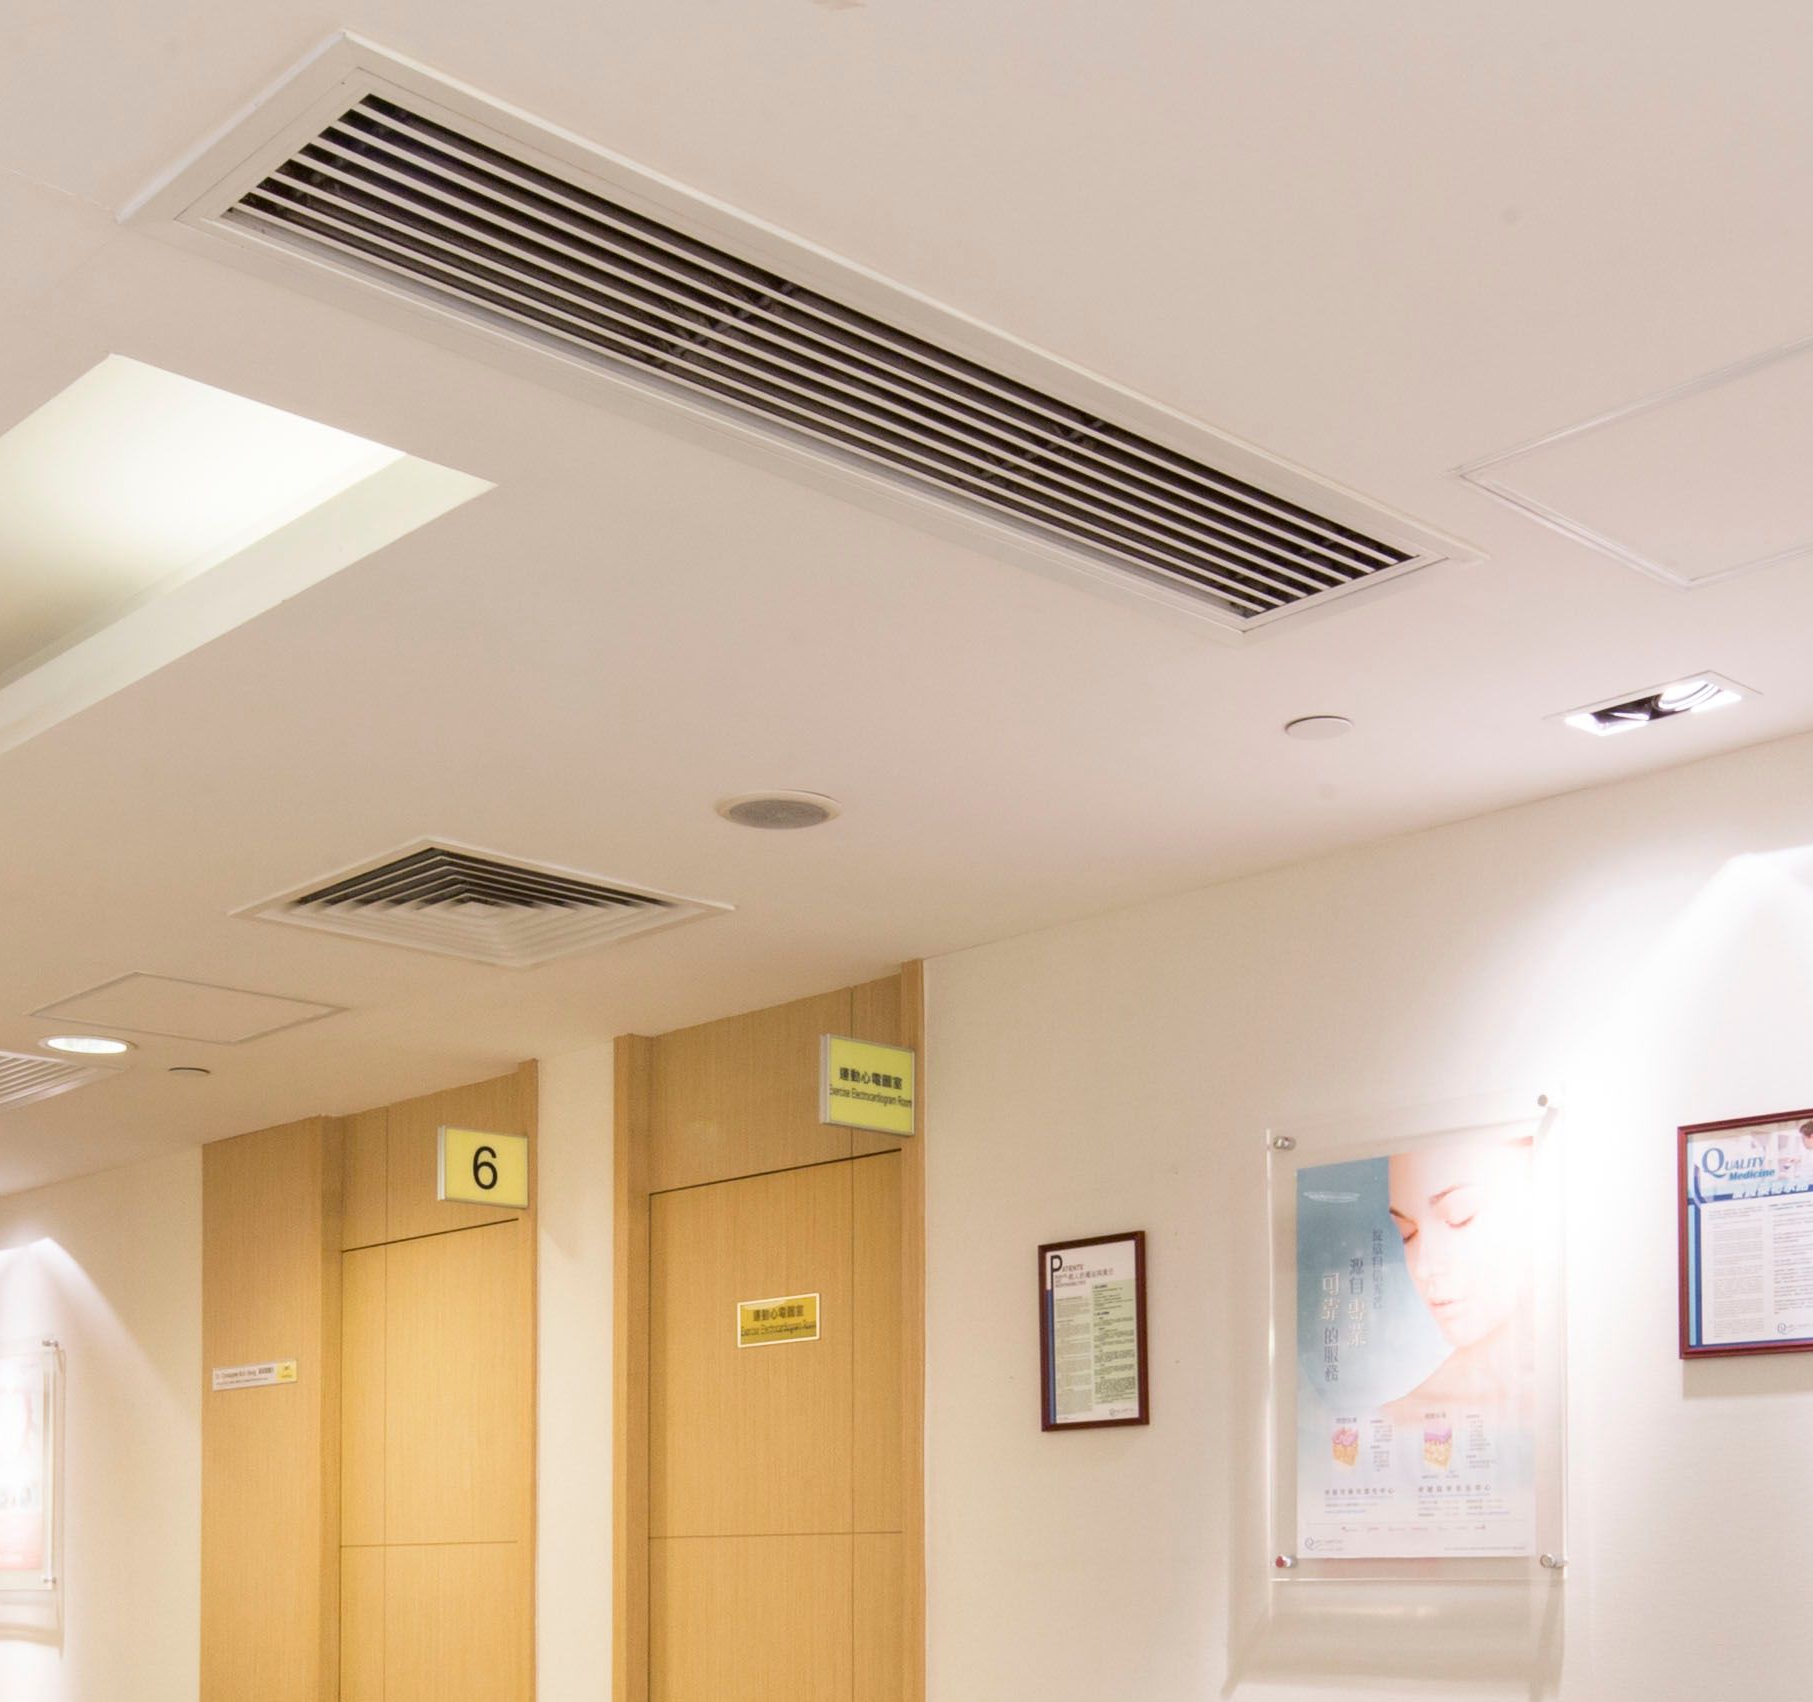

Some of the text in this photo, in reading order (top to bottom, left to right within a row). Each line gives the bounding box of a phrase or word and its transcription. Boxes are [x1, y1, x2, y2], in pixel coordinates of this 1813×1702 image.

[473, 1146, 498, 1190] 6
[1702, 1148, 1765, 1178] QUALITY
[1728, 1168, 1776, 1181] Medicine
[1321, 1272, 1340, 1382] 可靠的服務
